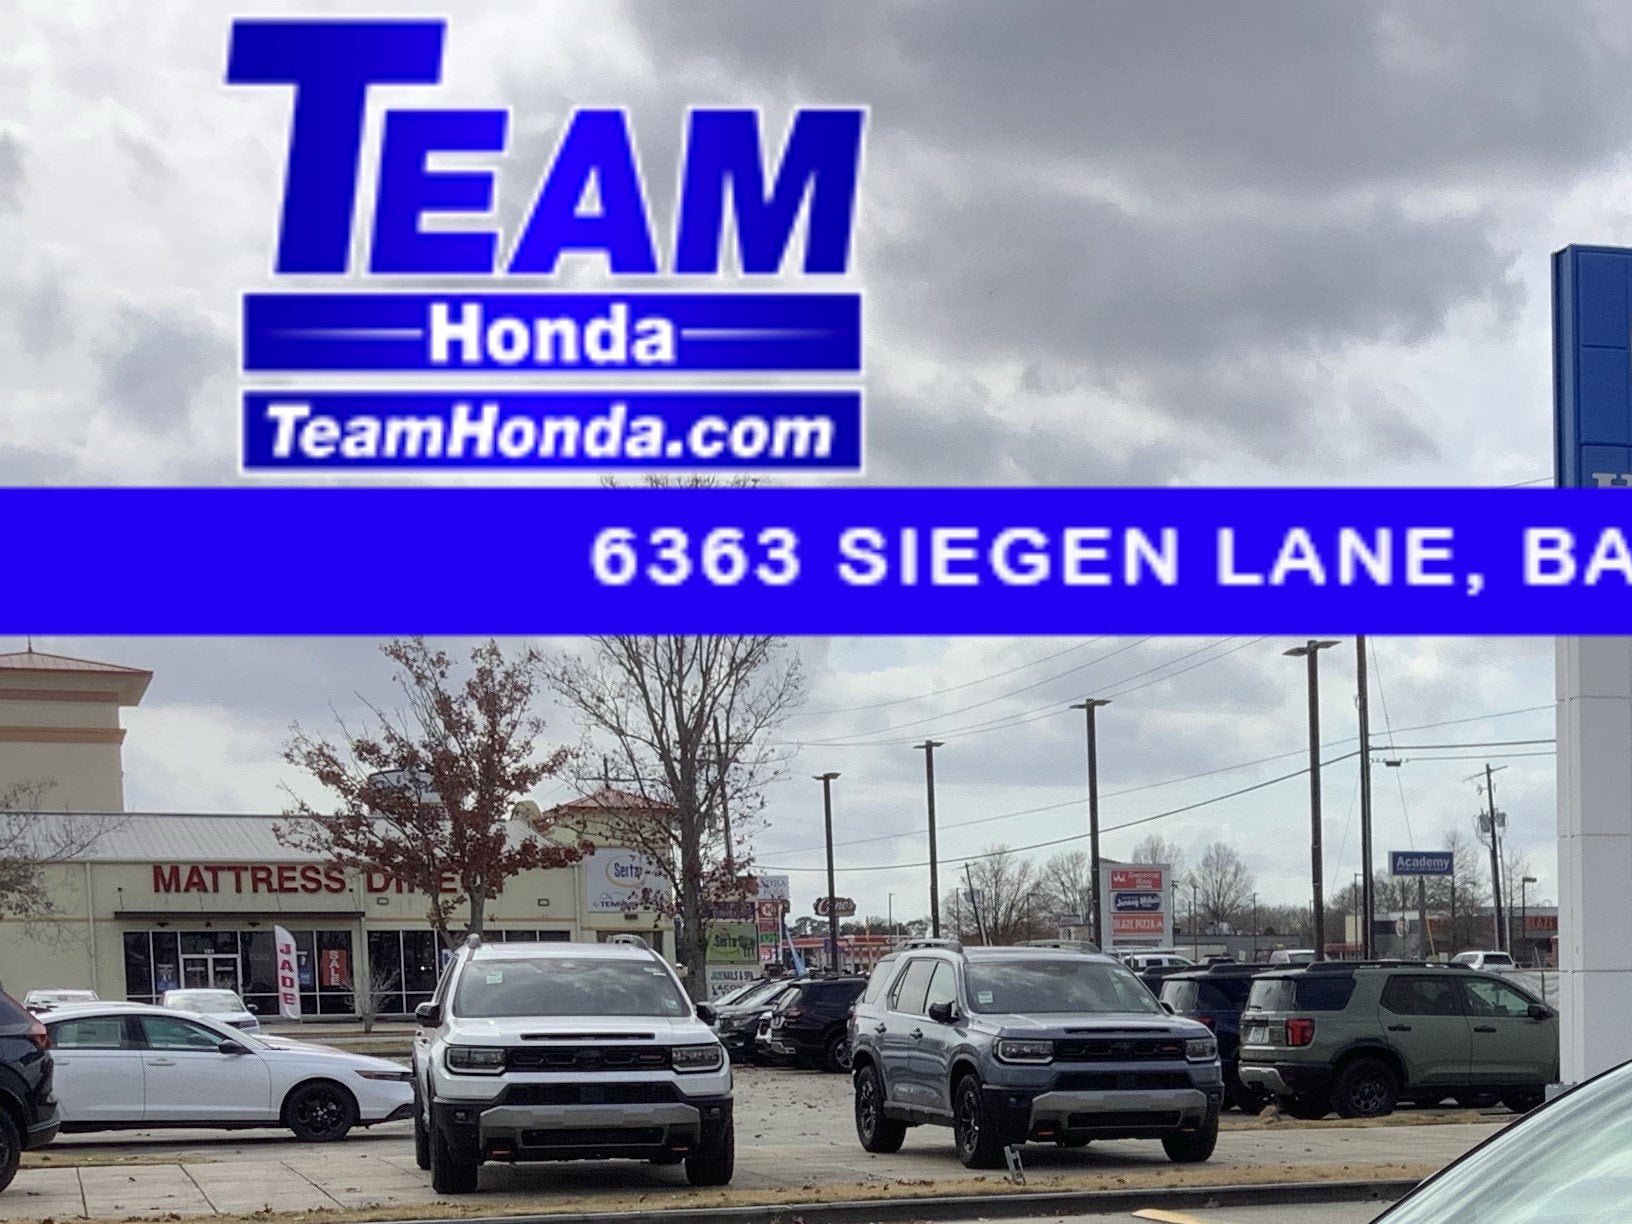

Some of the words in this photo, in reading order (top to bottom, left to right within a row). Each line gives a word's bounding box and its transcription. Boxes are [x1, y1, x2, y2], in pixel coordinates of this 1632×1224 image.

[1397, 856, 1449, 870] Academy
[153, 865, 345, 893] MATTRESS
[280, 943, 296, 1005] JADE
[330, 950, 339, 985] SALE
